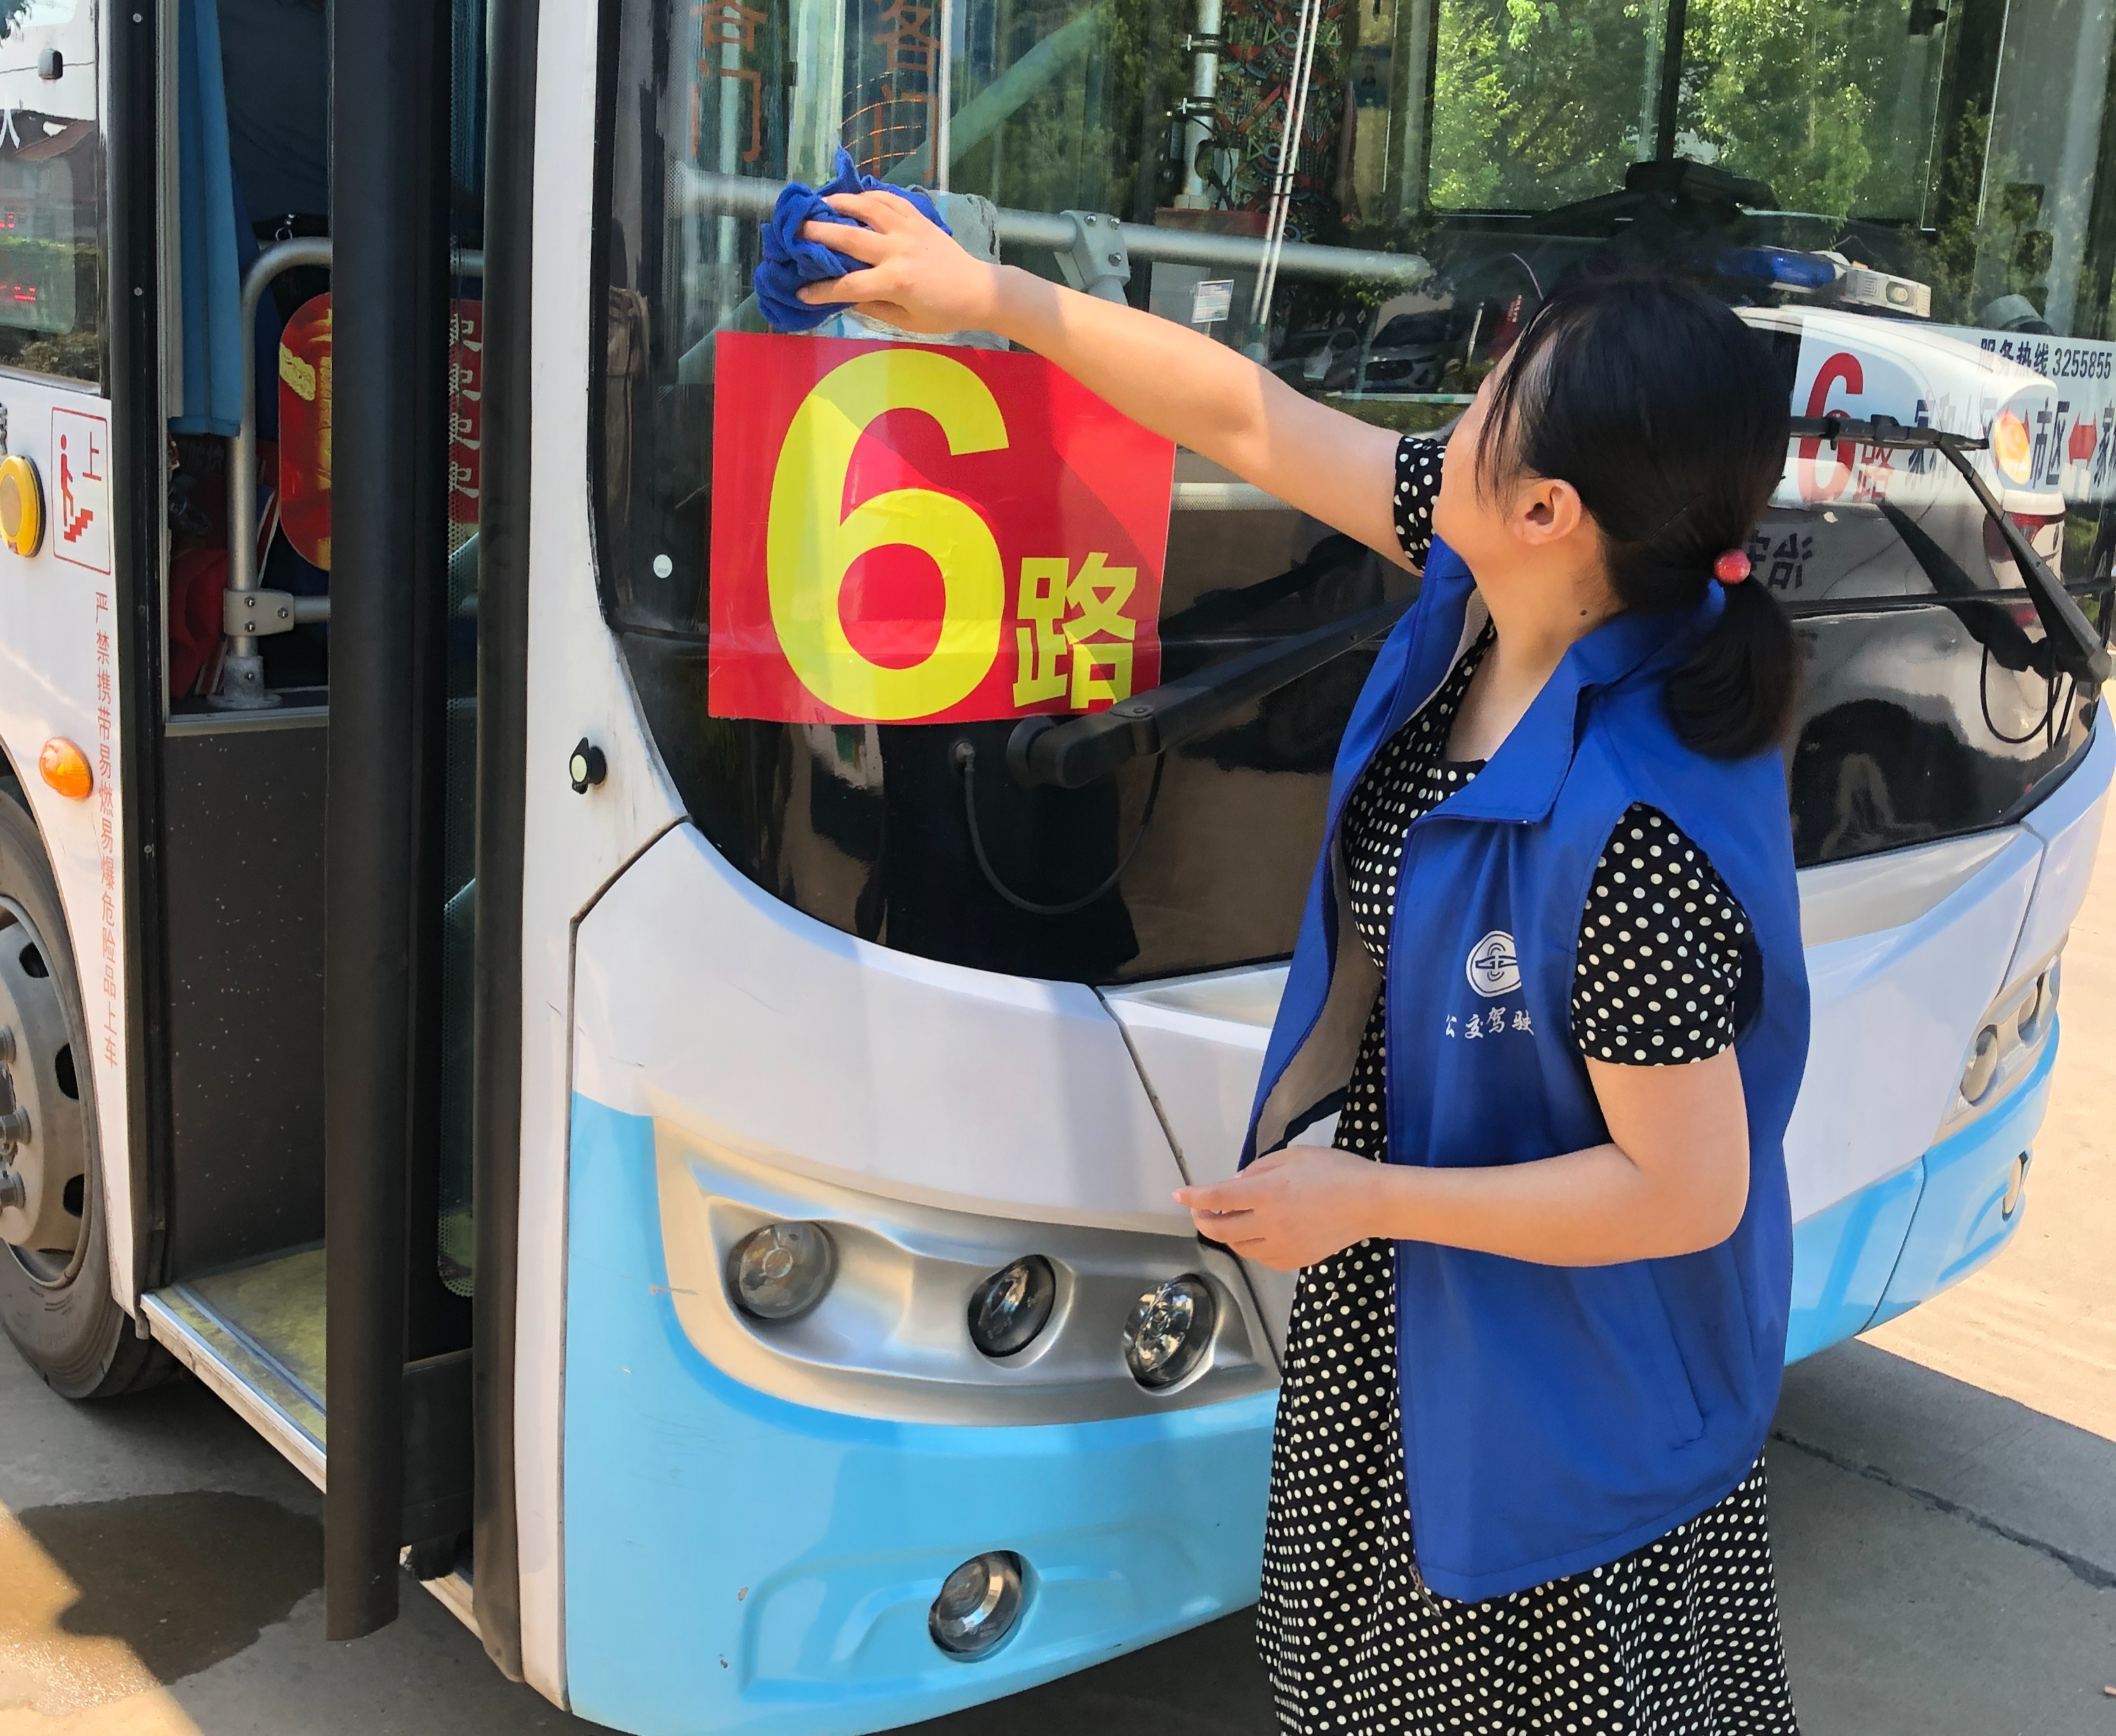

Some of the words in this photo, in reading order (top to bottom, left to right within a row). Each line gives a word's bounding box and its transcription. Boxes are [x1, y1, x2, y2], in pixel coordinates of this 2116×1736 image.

[1978, 338, 2049, 378] 服务热线
[2052, 348, 2112, 380] 3255855
[82, 432, 102, 481] 上
[2030, 396, 2070, 489] 市区
[767, 349, 1137, 720] 6路
[95, 592, 119, 1069] 严禁携带易燃易爆危险品上车
